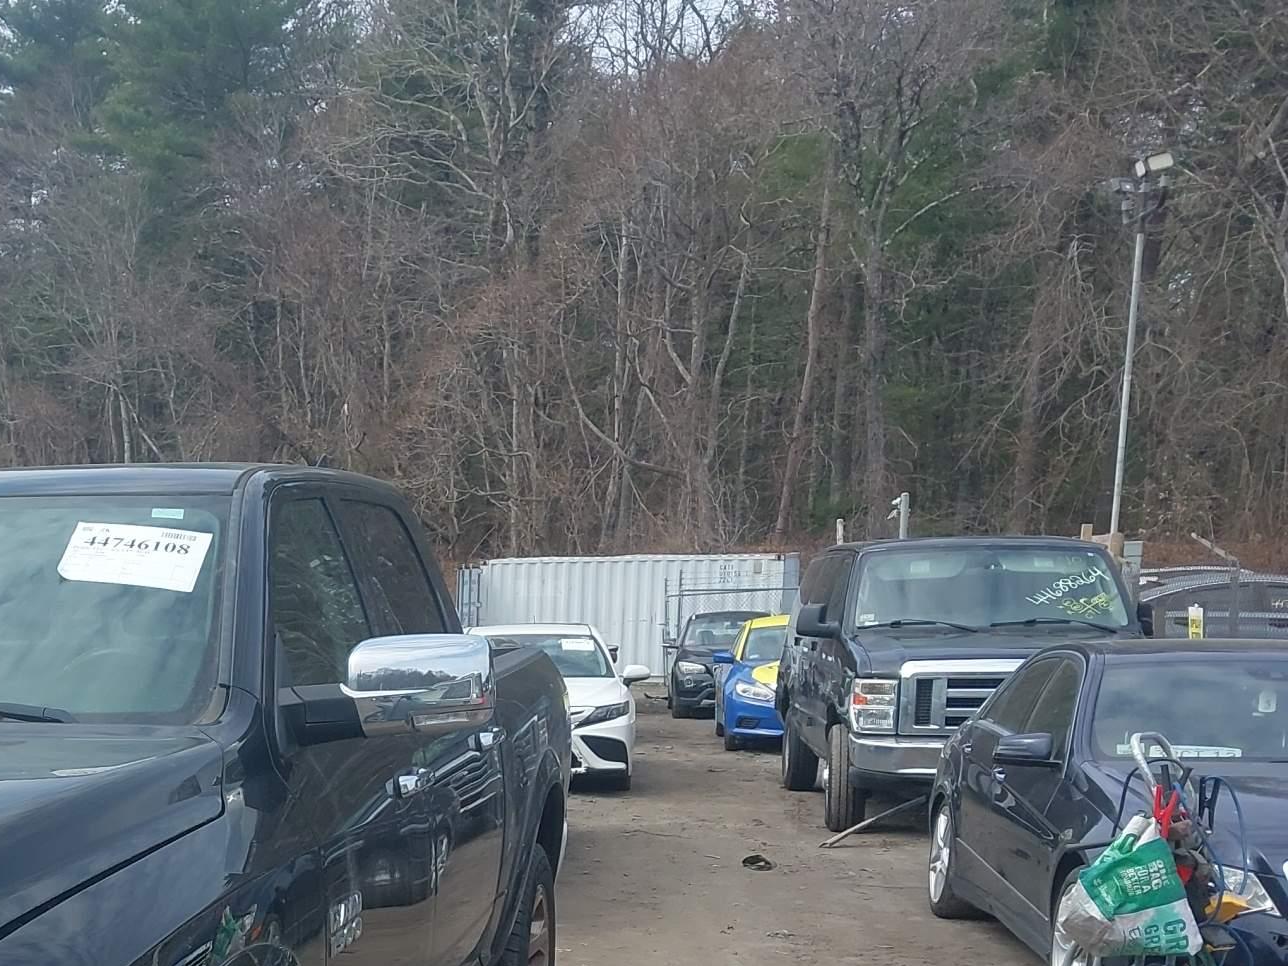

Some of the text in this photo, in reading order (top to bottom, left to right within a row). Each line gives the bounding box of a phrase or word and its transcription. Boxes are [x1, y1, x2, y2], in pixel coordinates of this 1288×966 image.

[83, 536, 191, 555] 44746108
[1025, 566, 1110, 605] 44688264
[1126, 868, 1143, 896] BETTER
[1134, 865, 1152, 893] FOR A
[1148, 861, 1163, 891] BAG
